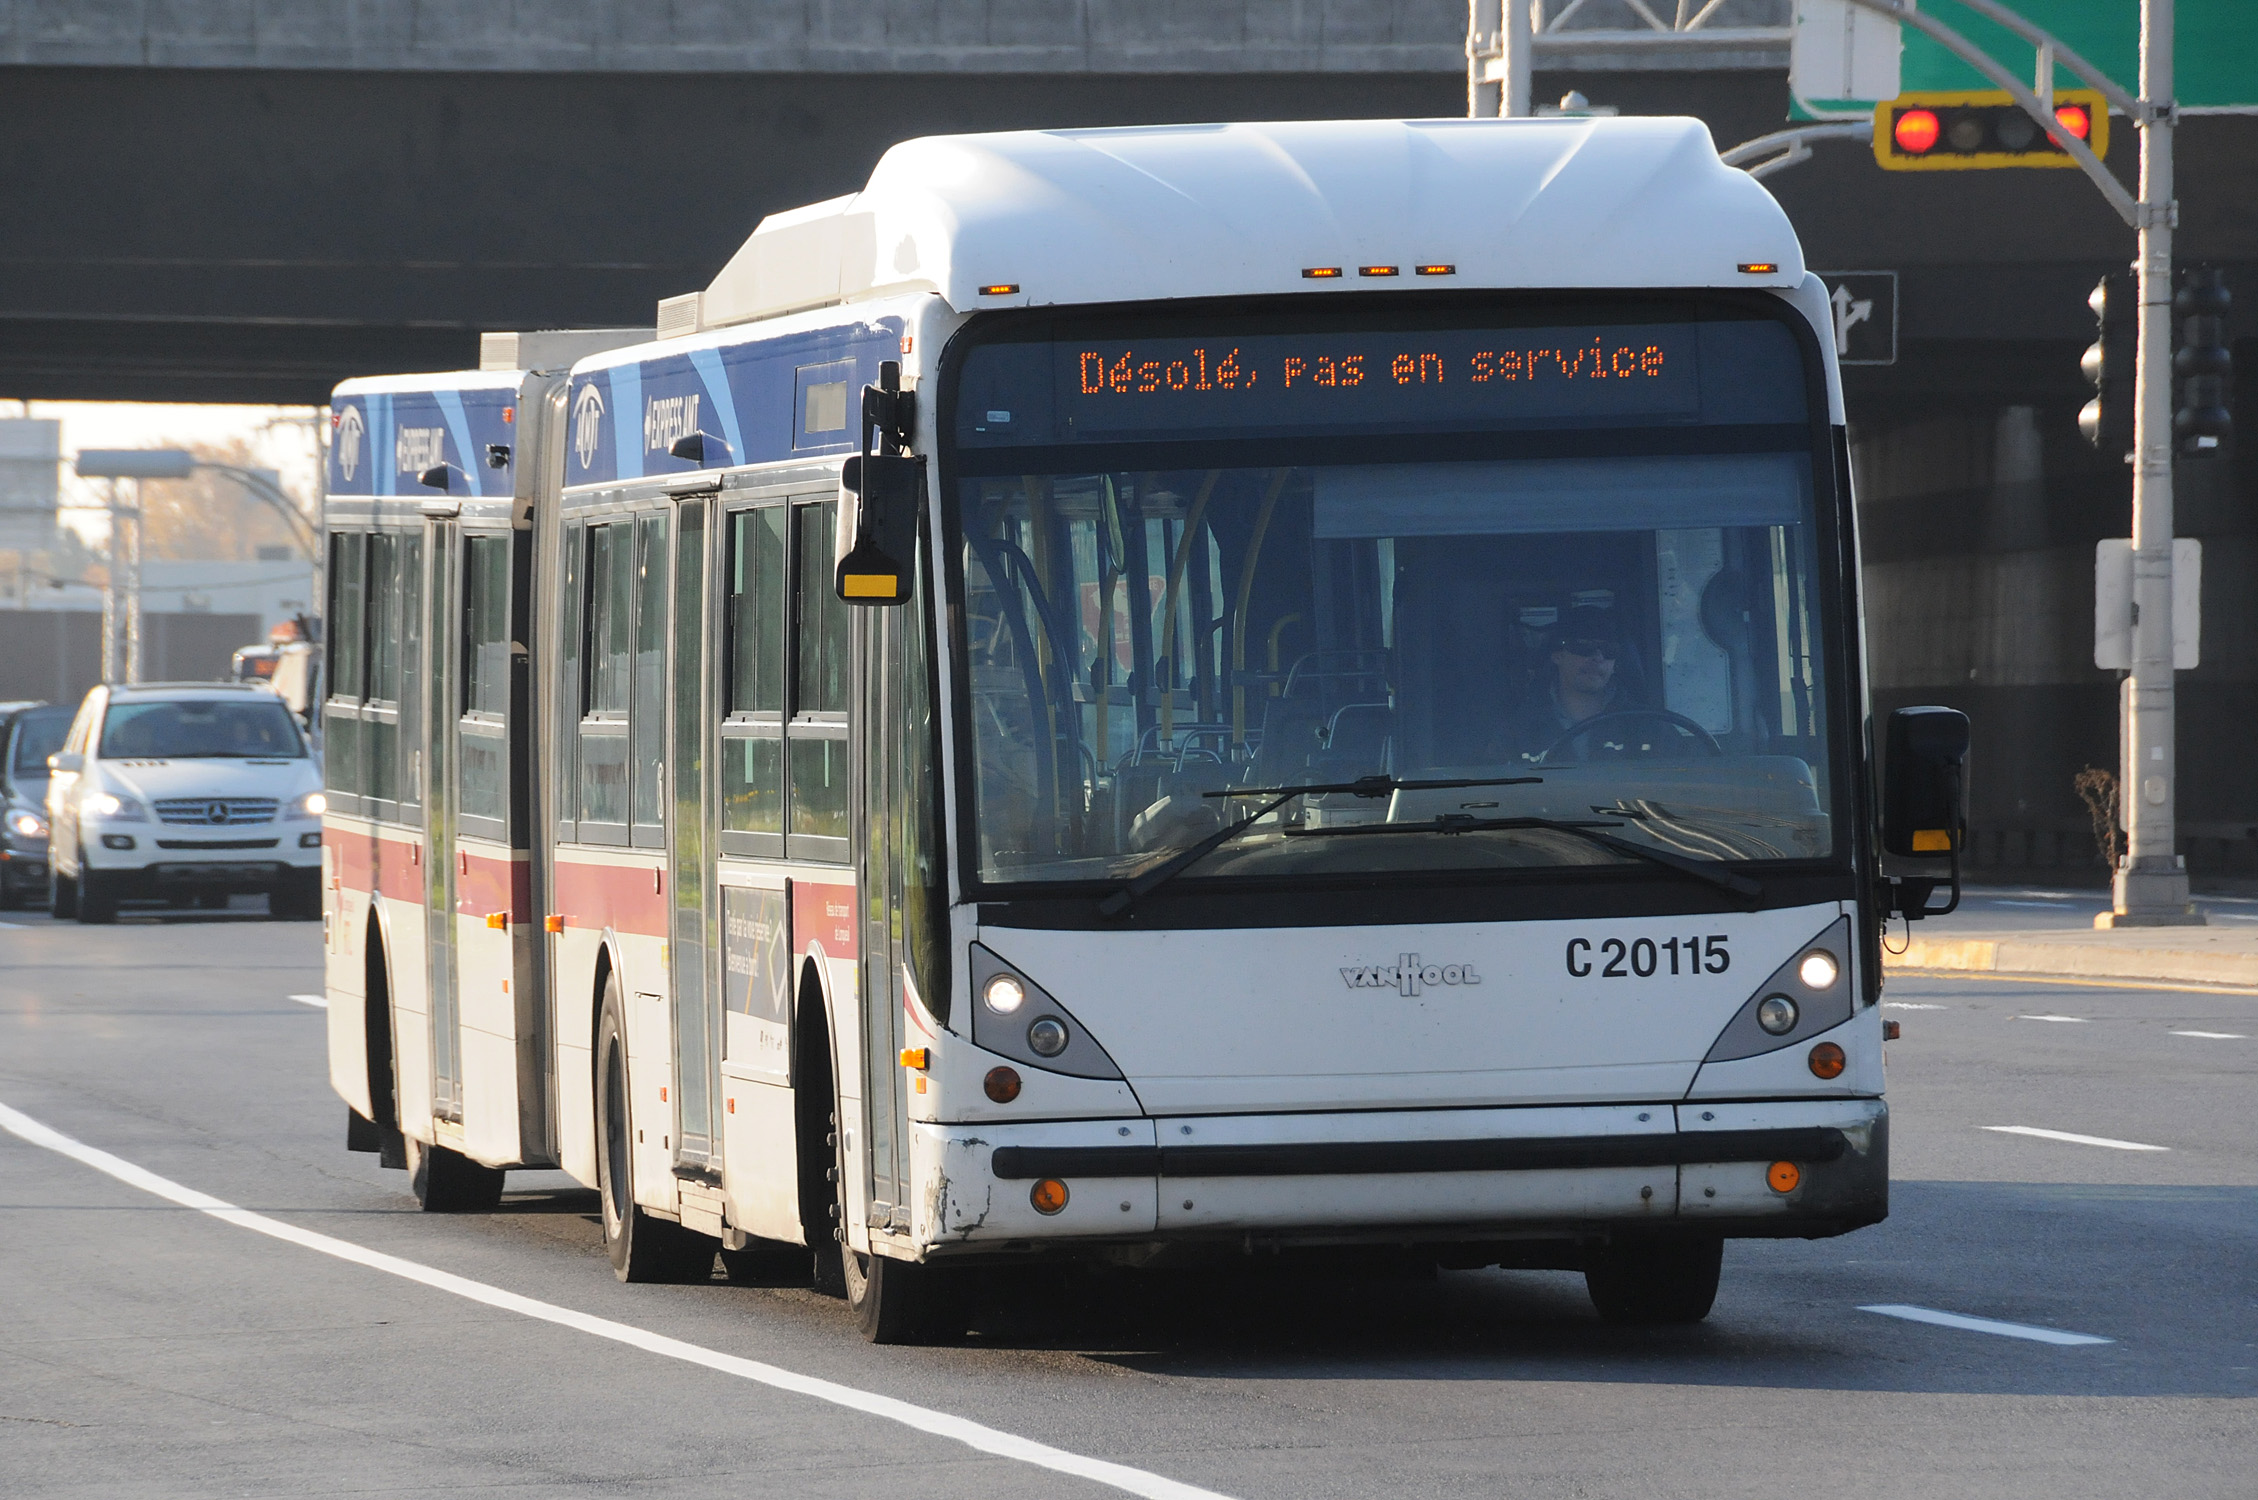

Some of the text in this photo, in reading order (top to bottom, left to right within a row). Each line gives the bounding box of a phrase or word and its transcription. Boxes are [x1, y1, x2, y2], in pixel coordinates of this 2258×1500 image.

[1080, 348, 1257, 394] Désolé,
[1392, 353, 1444, 385] en
[1471, 336, 1664, 382] service
